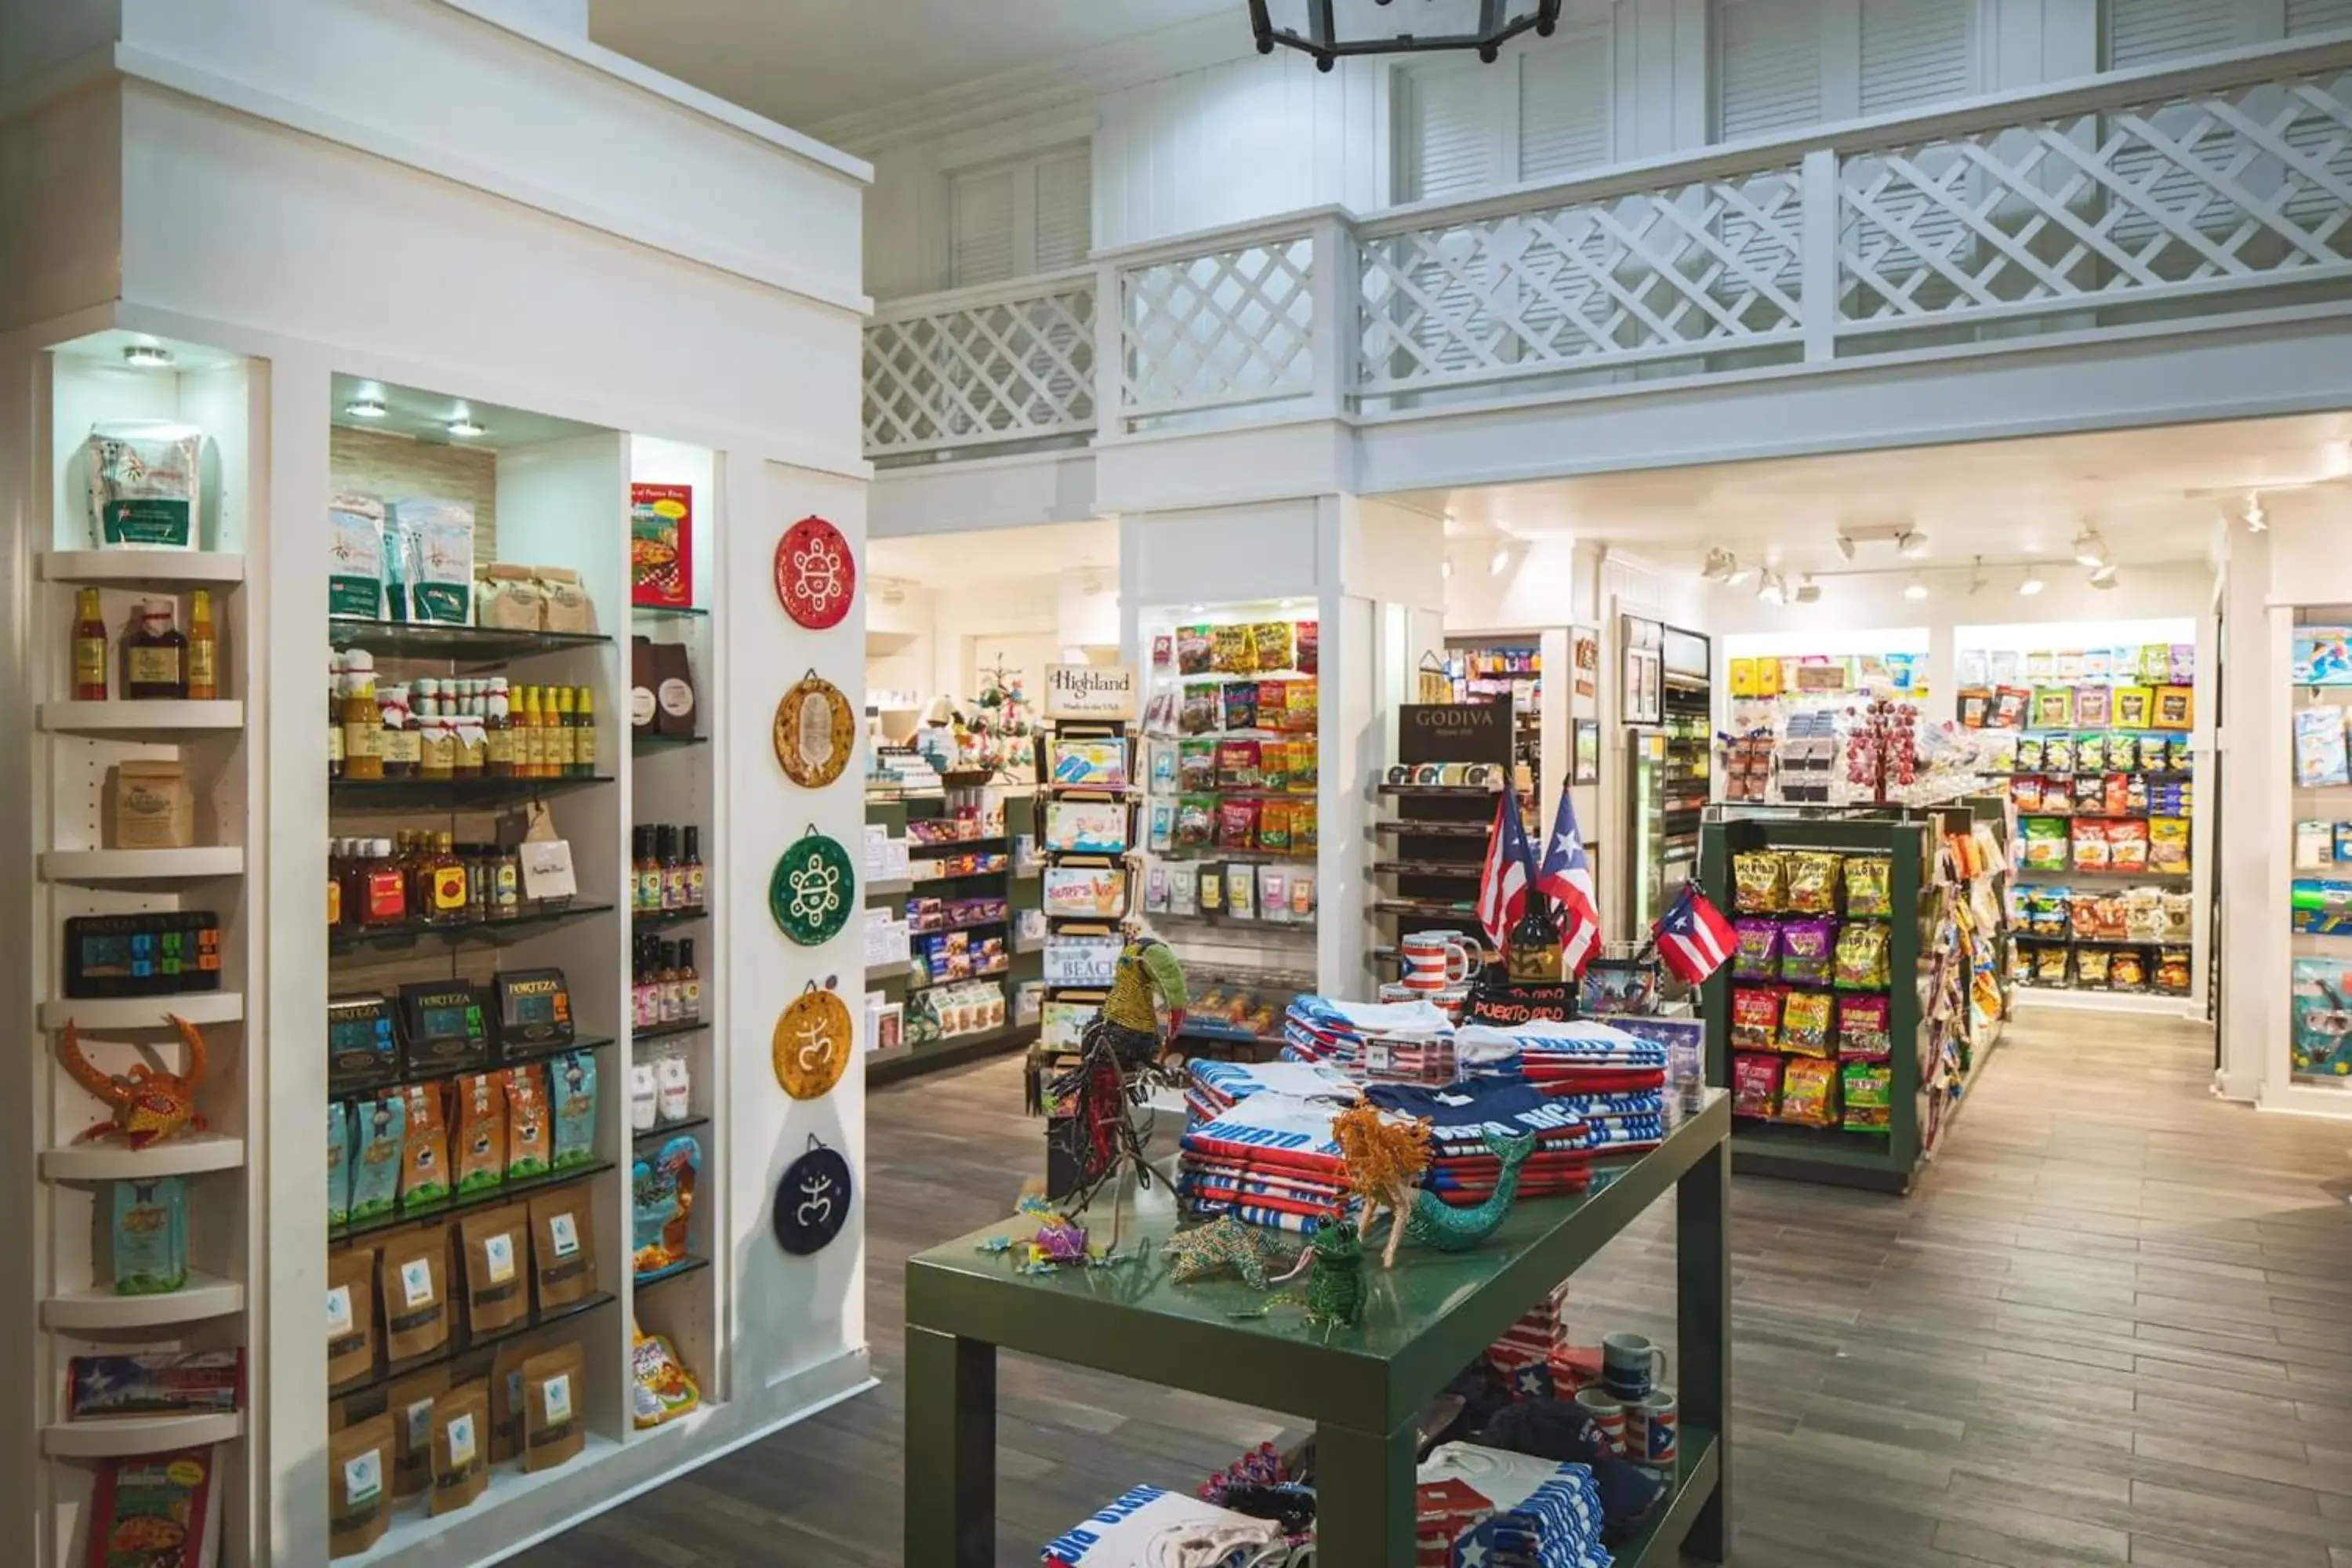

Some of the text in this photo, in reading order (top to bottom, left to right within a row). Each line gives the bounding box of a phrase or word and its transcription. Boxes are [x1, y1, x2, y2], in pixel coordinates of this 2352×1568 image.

[1055, 670, 1130, 699] Highland
[1416, 710, 1493, 727] GODIVA
[1474, 1002, 1563, 1022] PUERTO RICO
[1201, 1120, 1312, 1149] PUERTO
